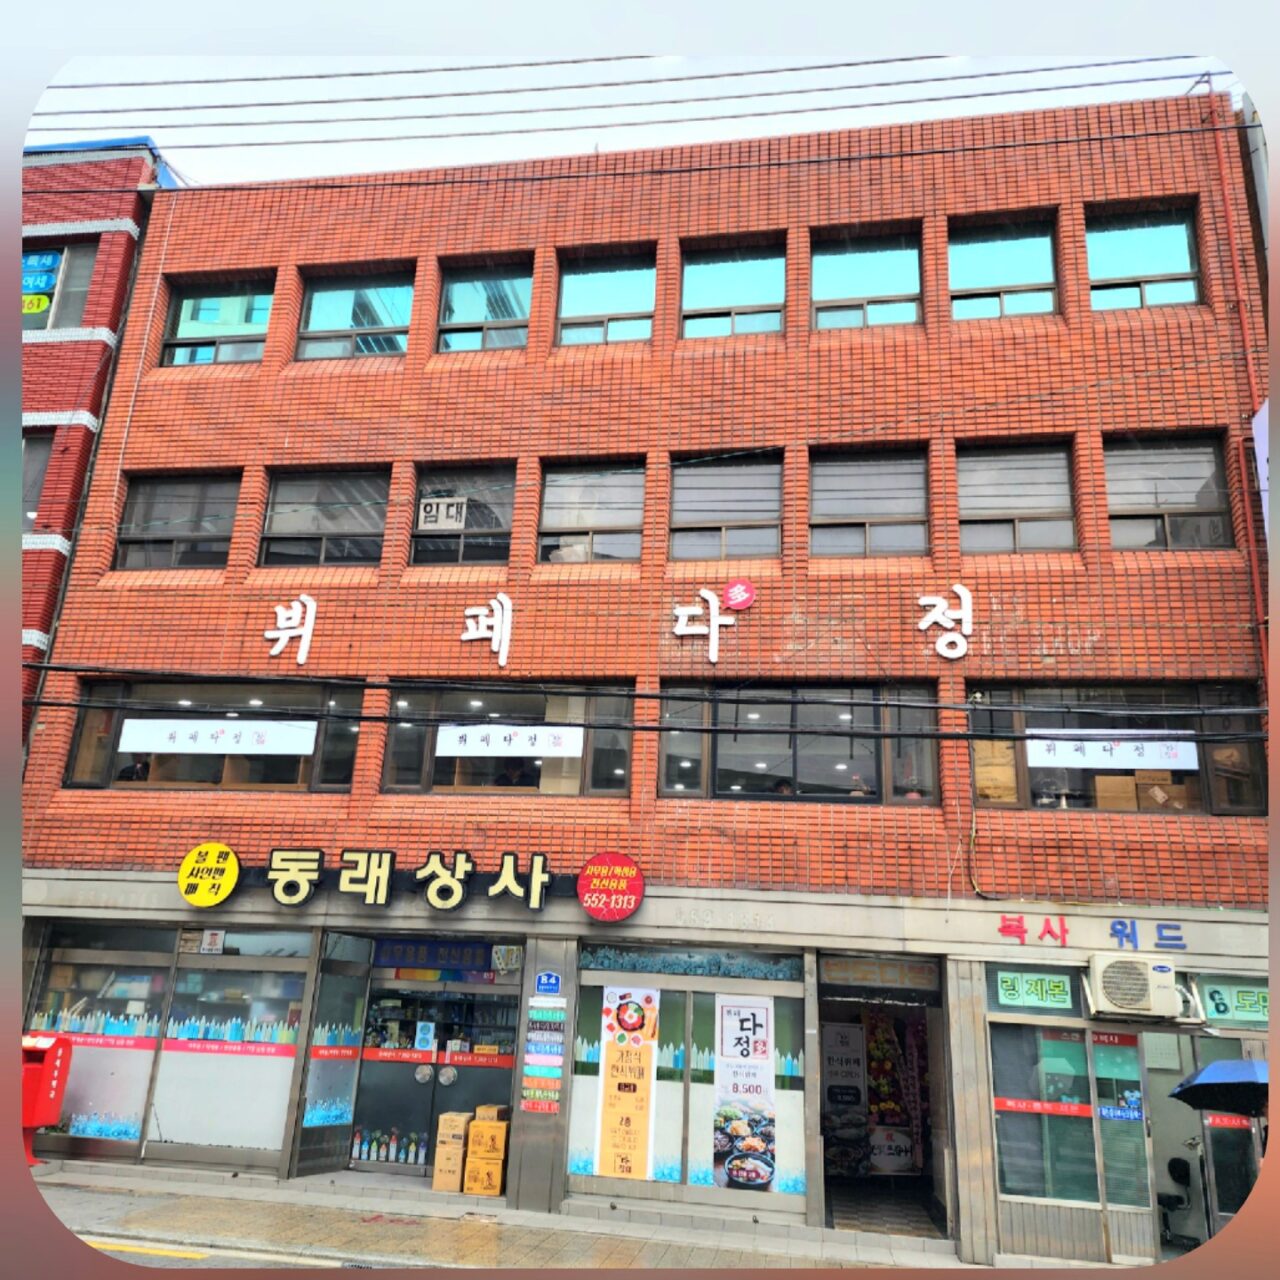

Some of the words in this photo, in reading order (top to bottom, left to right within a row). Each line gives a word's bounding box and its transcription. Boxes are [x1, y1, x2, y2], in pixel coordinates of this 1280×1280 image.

[423, 499, 464, 524] 임대
[267, 850, 550, 909] 동래상사
[583, 893, 636, 910] 552-1313
[998, 914, 1069, 948] 복사
[1110, 920, 1187, 950] 워드
